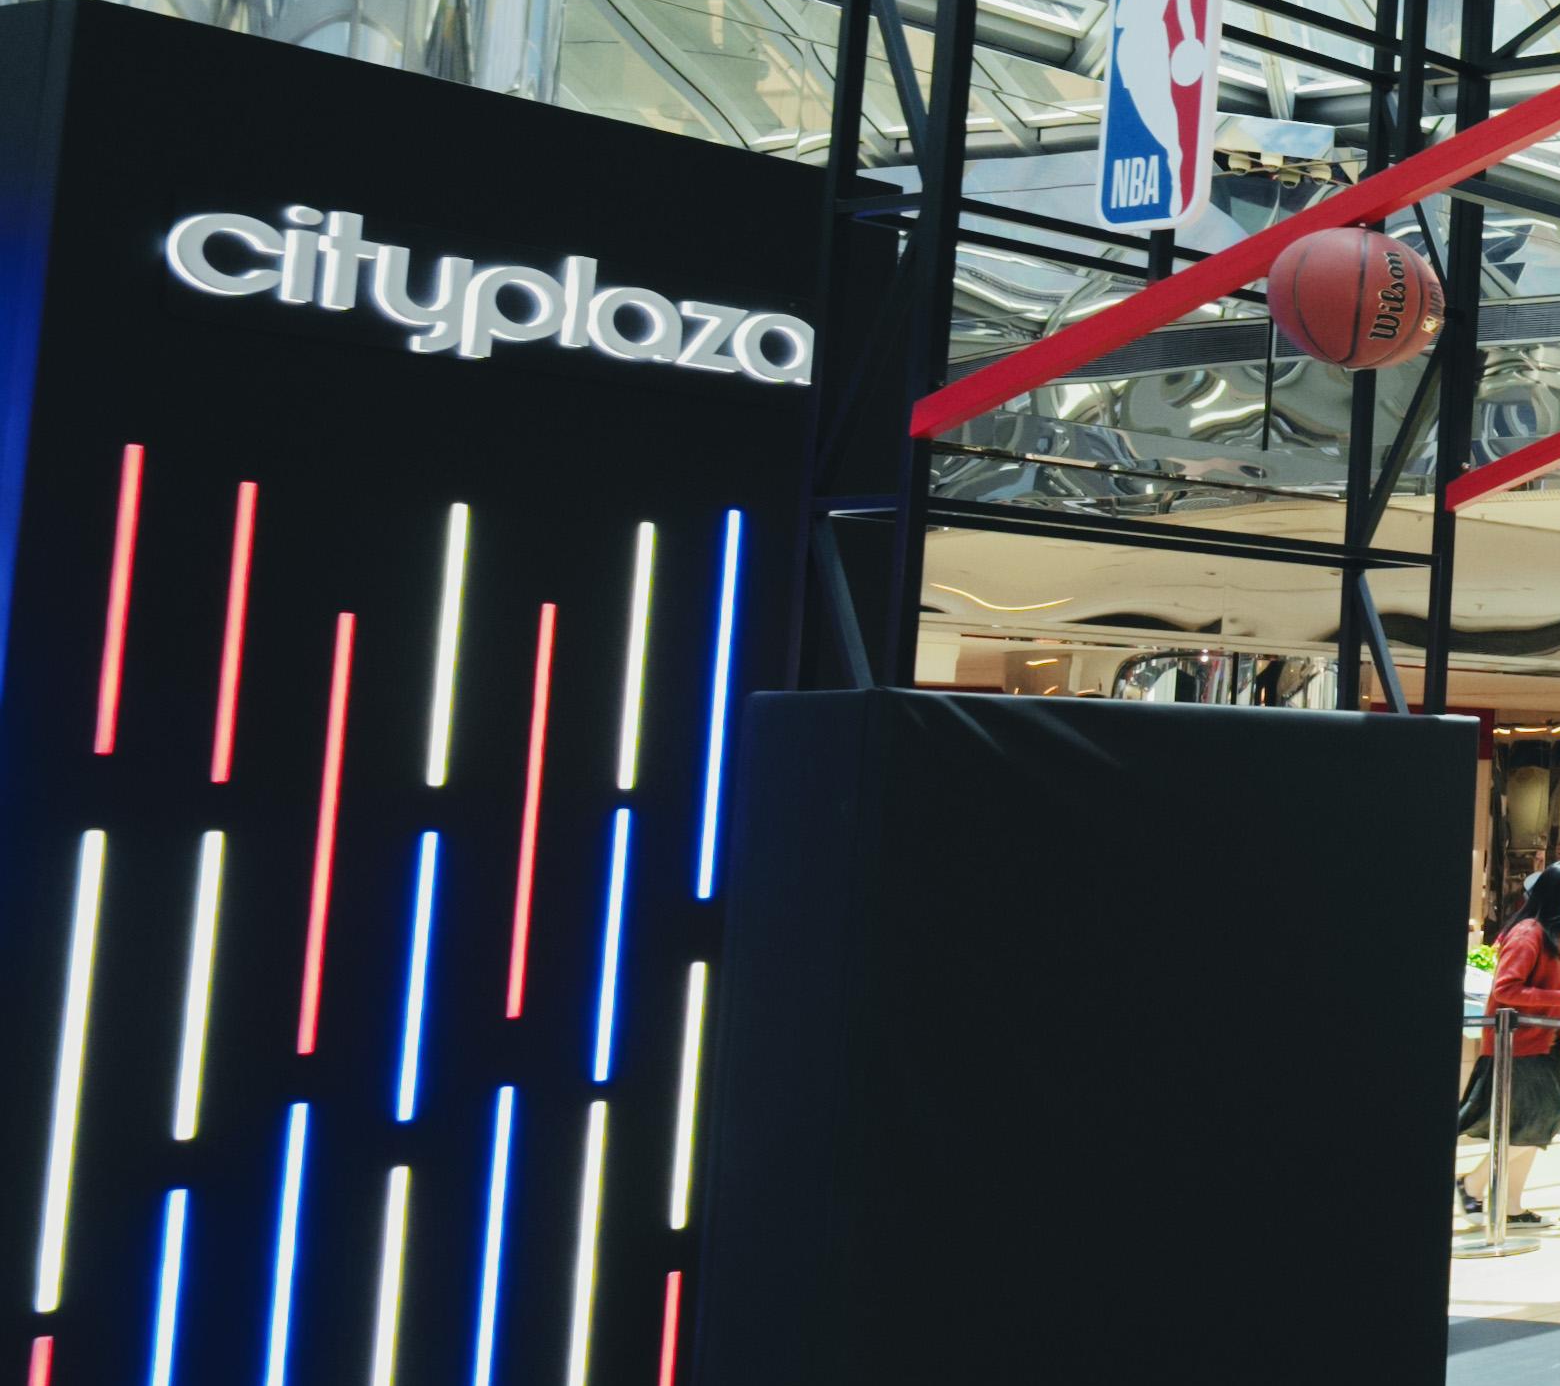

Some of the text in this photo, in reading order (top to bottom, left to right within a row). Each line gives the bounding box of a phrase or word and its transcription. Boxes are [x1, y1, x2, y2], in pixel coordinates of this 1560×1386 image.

[1109, 154, 1160, 210] NBA
[165, 204, 816, 387] cityplaza
[1368, 251, 1406, 341] Wilson
